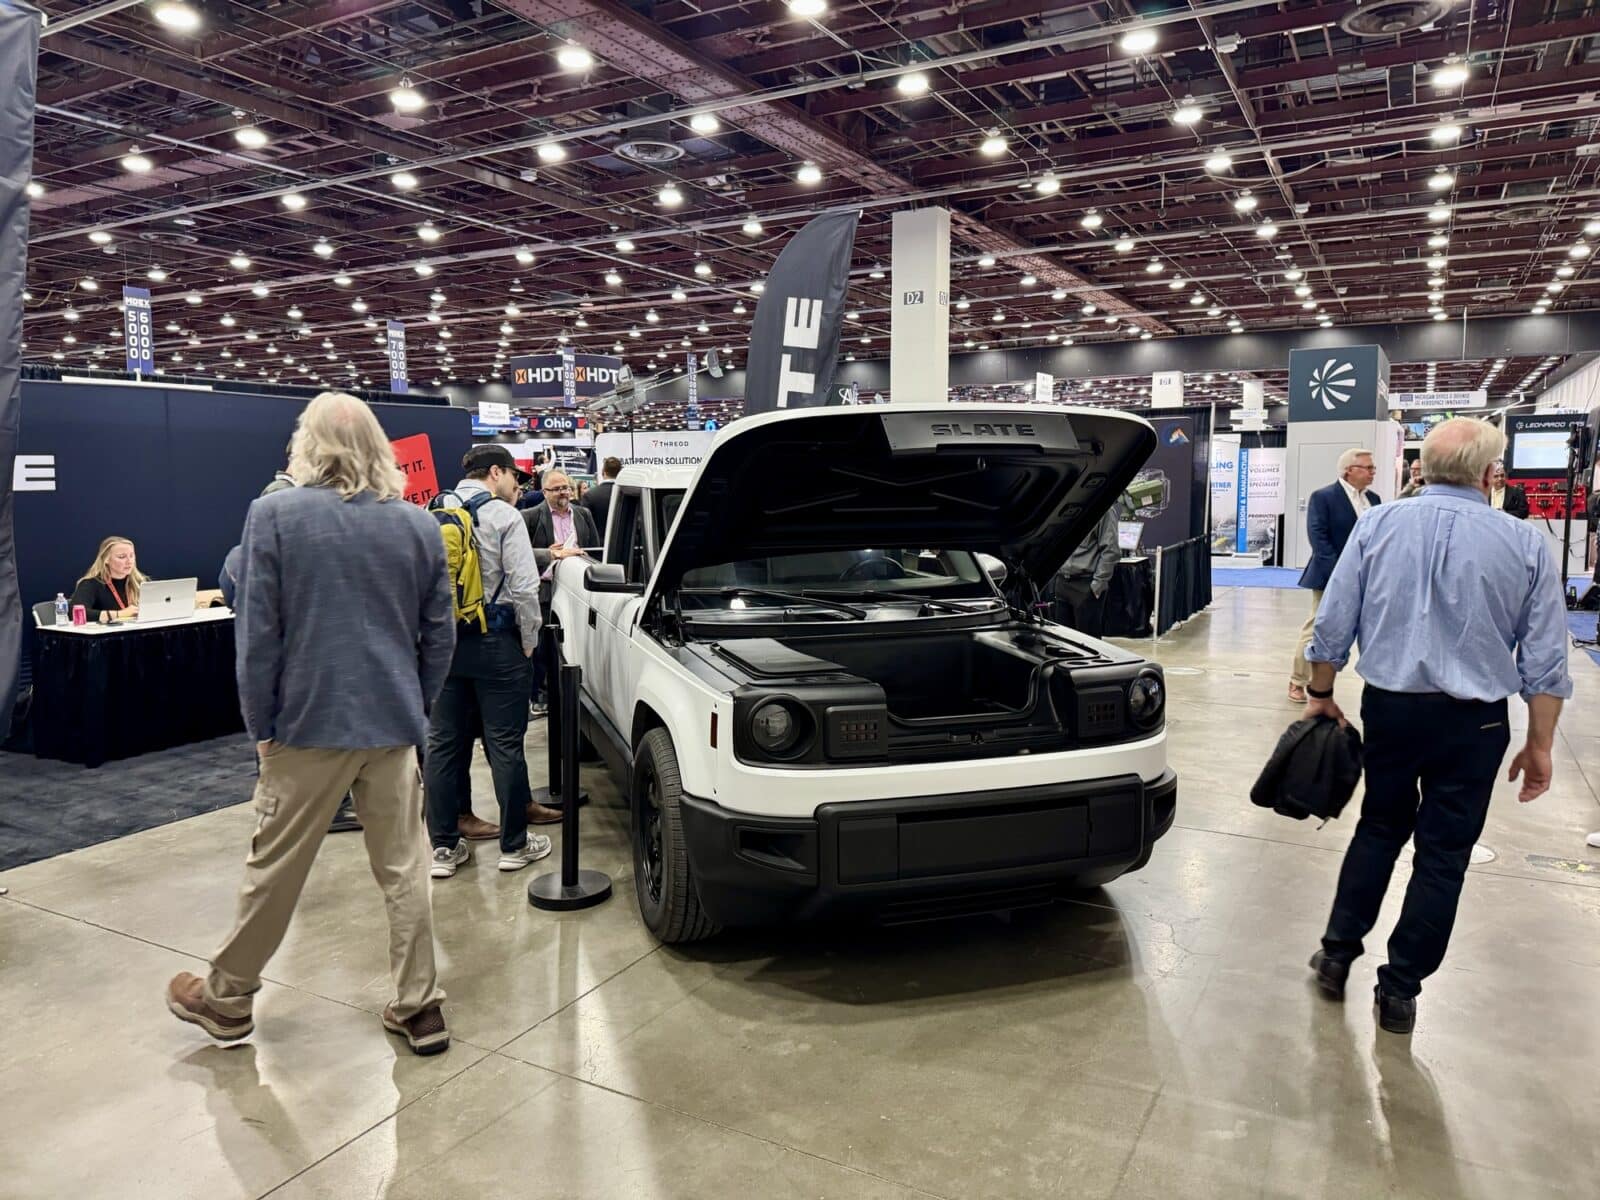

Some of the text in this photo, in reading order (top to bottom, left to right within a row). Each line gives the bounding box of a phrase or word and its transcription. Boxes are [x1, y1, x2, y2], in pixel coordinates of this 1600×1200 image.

[906, 291, 921, 305] D2
[128, 310, 138, 359] 5000
[140, 312, 150, 360] 6000
[528, 367, 564, 383] HDT
[586, 367, 619, 384] HDT
[544, 417, 572, 429] Ohio
[931, 423, 1035, 437] SLATE
[1525, 421, 1566, 429] LEONARDO
